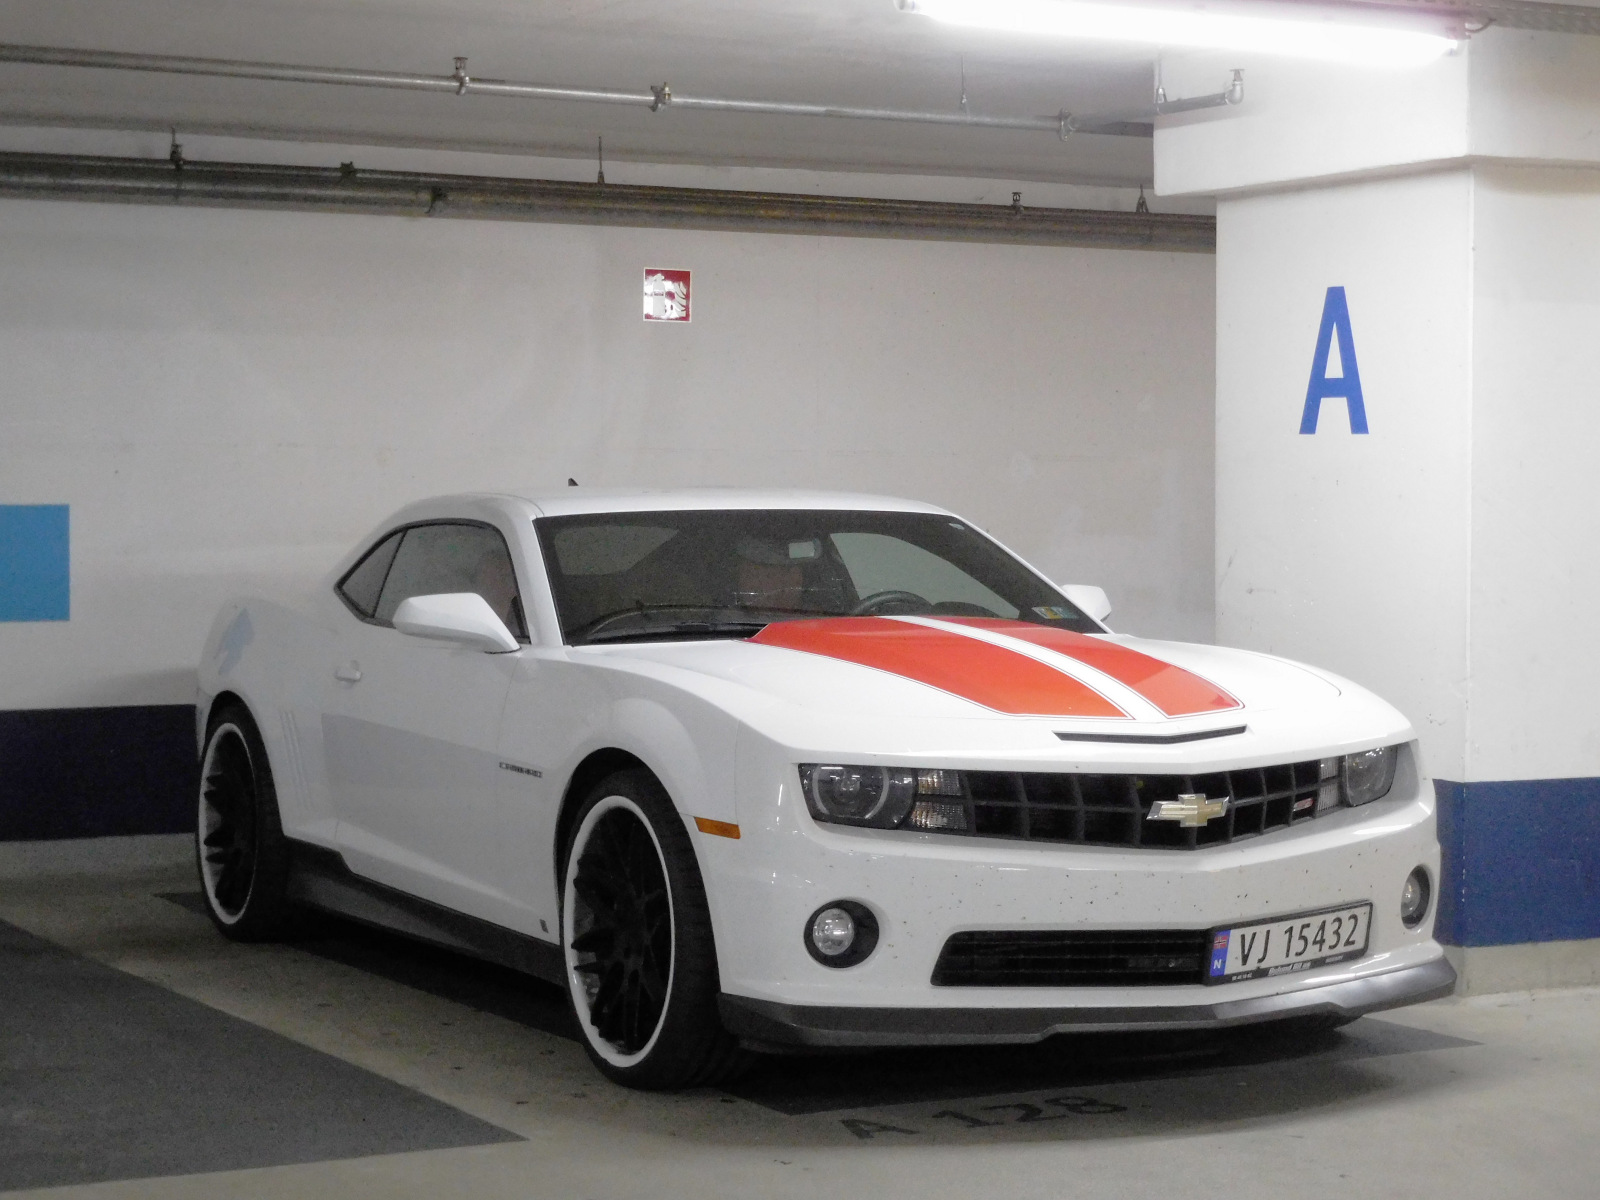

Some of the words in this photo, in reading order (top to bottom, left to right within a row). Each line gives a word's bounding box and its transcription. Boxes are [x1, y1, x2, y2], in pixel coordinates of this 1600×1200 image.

[1299, 286, 1369, 434] A
[1240, 929, 1271, 966] VJ
[1284, 913, 1359, 959] 15432
[1213, 959, 1222, 969] N
[838, 1118, 920, 1139] A
[931, 1096, 1128, 1128] 128
